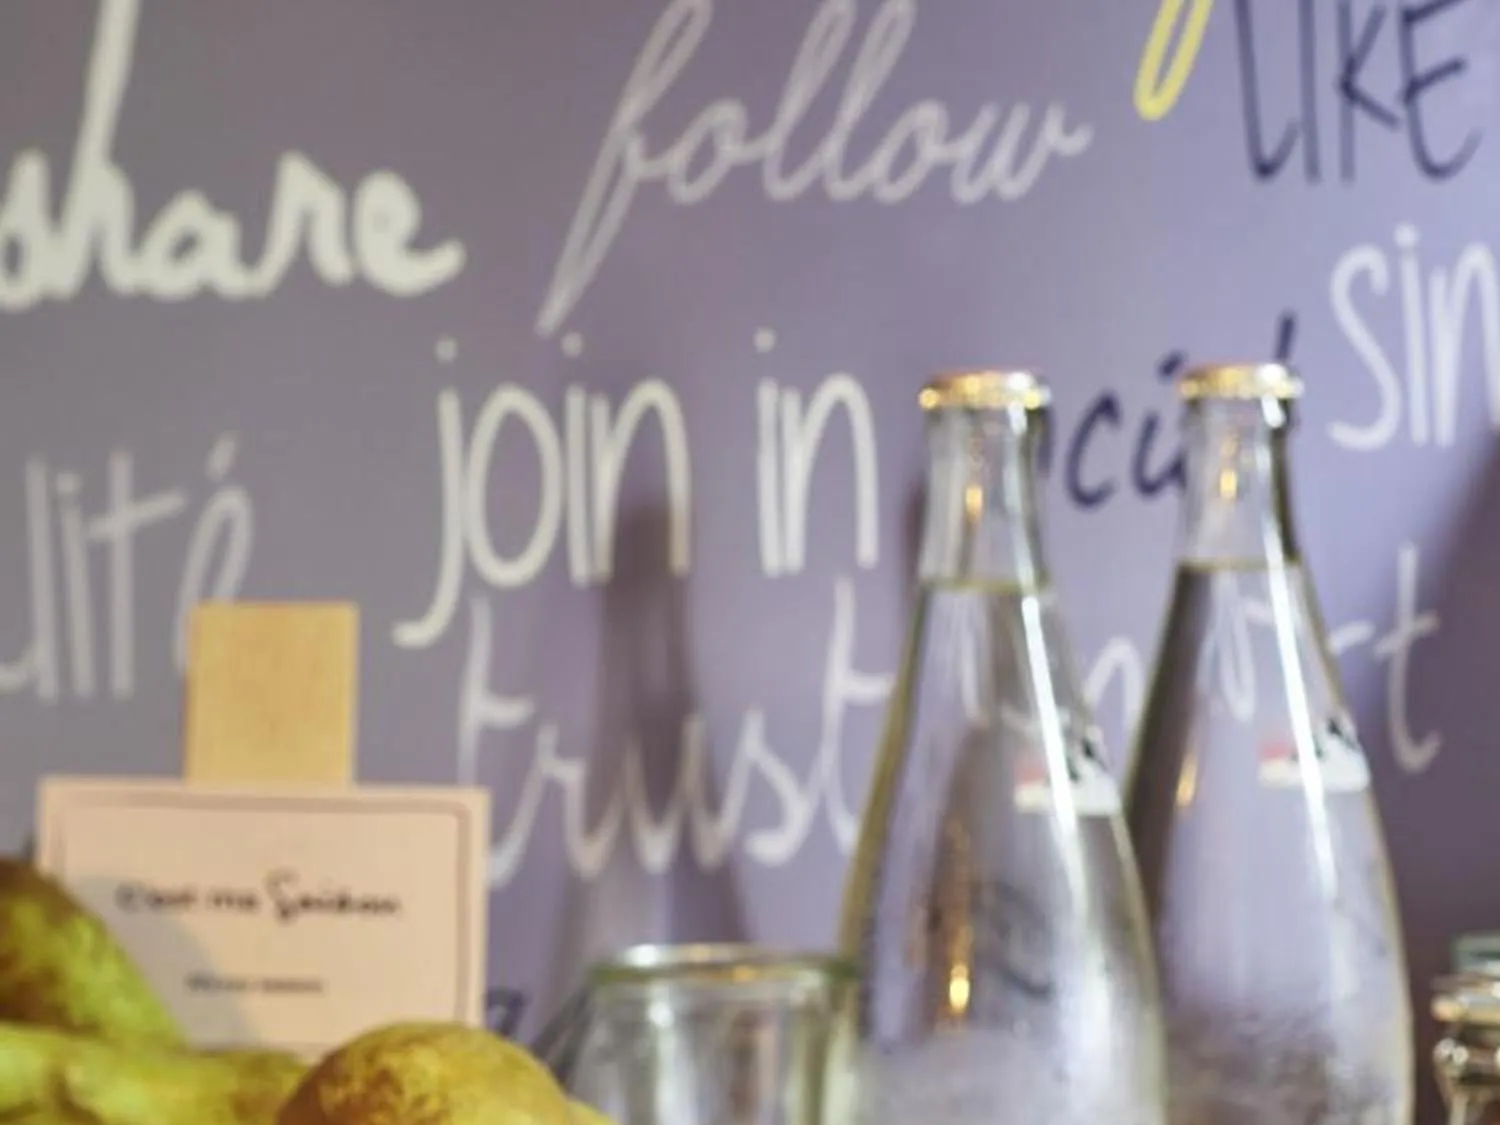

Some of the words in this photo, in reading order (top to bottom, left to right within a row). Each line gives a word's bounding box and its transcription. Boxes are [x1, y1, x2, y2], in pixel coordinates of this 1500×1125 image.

[0, 0, 467, 312] share
[535, 0, 1093, 338] follow
[0, 430, 255, 702] lité
[392, 335, 692, 648] join
[752, 328, 880, 577] in
